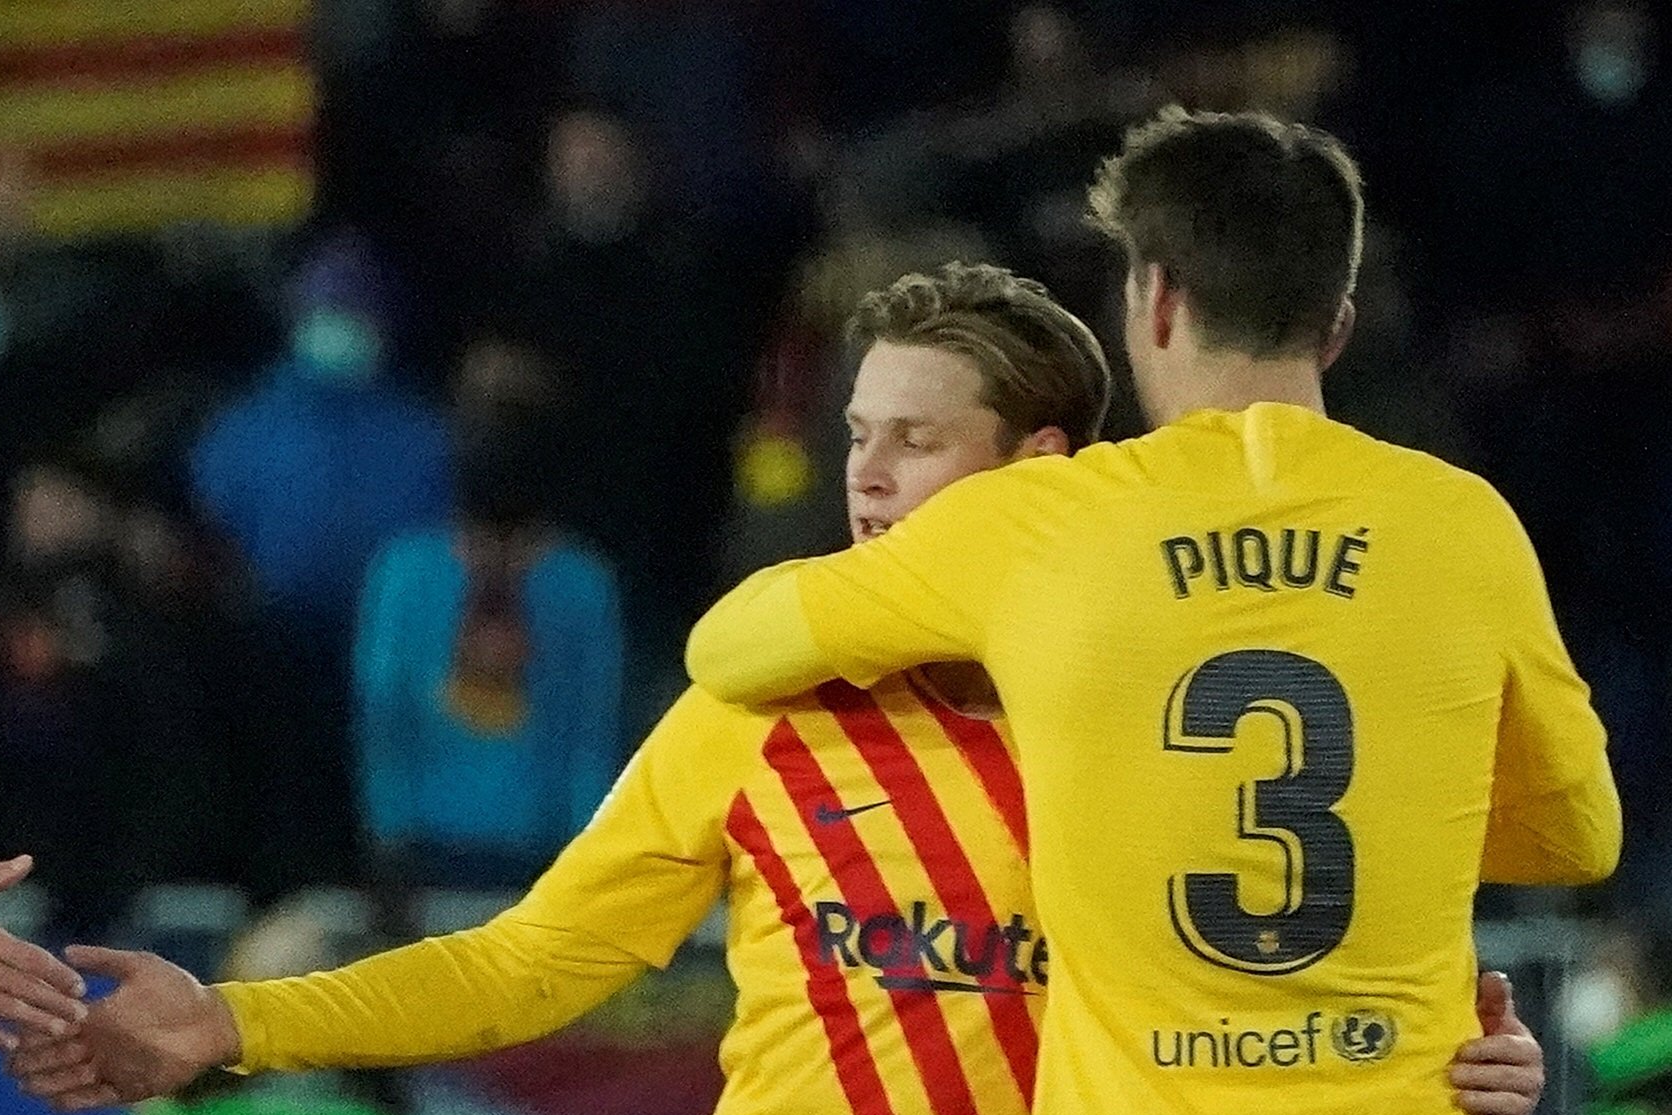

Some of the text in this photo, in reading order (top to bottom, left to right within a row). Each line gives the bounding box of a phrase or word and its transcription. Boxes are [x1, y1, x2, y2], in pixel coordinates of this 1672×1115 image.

[1160, 527, 1370, 599] PIQUÉ
[1163, 648, 1356, 975] 3
[1152, 1012, 1321, 1068] unicef
